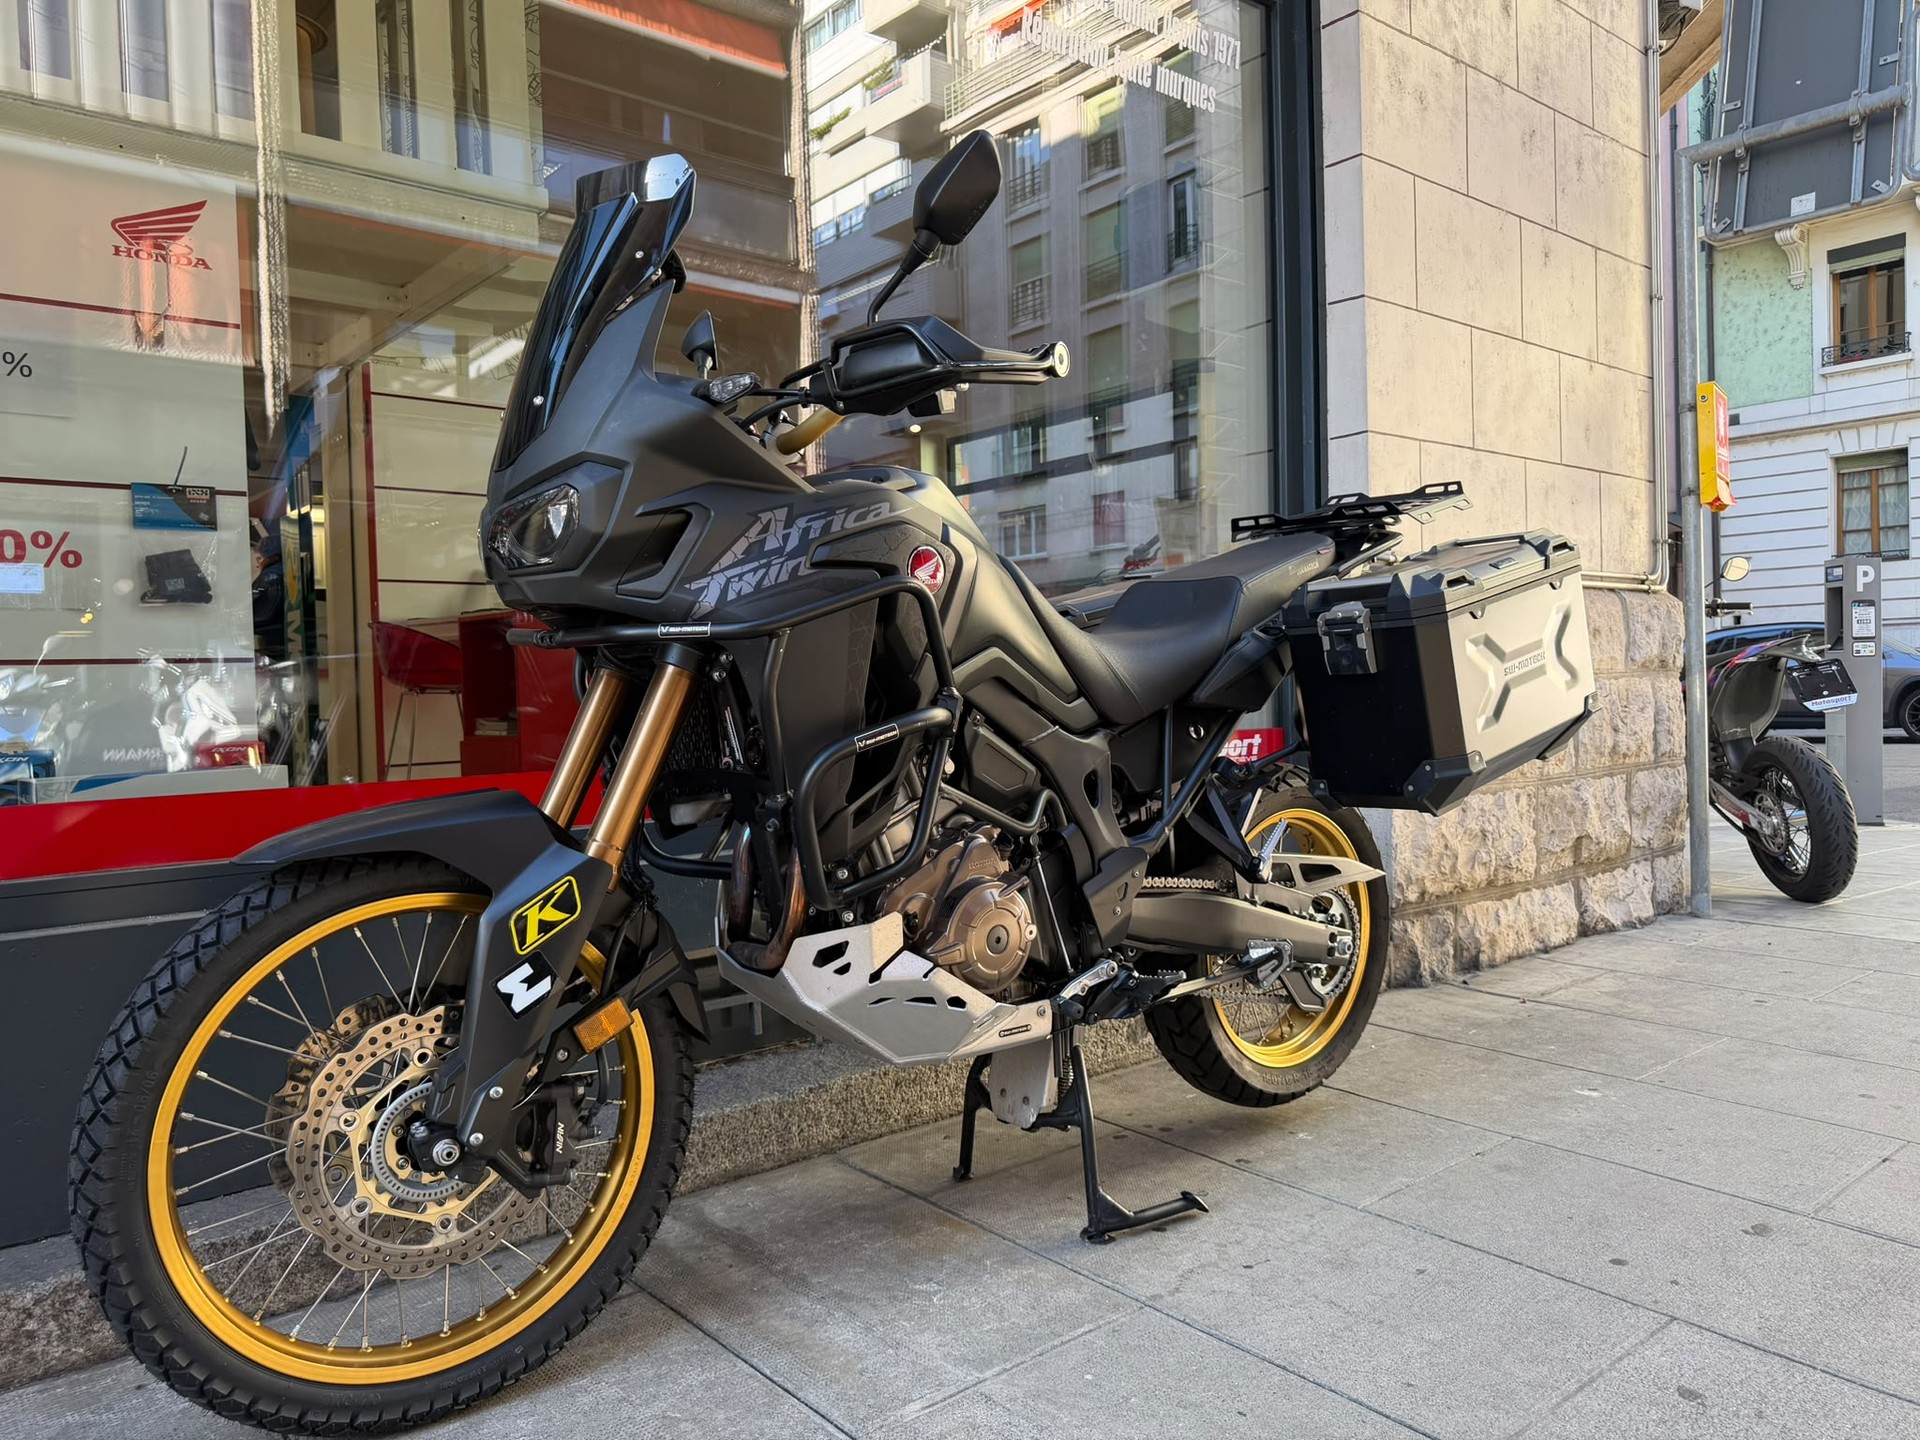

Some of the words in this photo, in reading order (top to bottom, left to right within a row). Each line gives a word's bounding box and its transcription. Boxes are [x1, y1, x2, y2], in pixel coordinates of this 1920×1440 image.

[1021, 4, 1109, 68] Réparation
[1155, 64, 1217, 113] marques
[1163, 13, 1208, 56] depuis
[1213, 31, 1240, 70] 1971
[112, 245, 212, 270] HONDA
[0, 529, 83, 568] 0%
[707, 502, 914, 574] Africa
[684, 553, 818, 622] Twin
[1856, 565, 1875, 592] P
[521, 882, 572, 950] K
